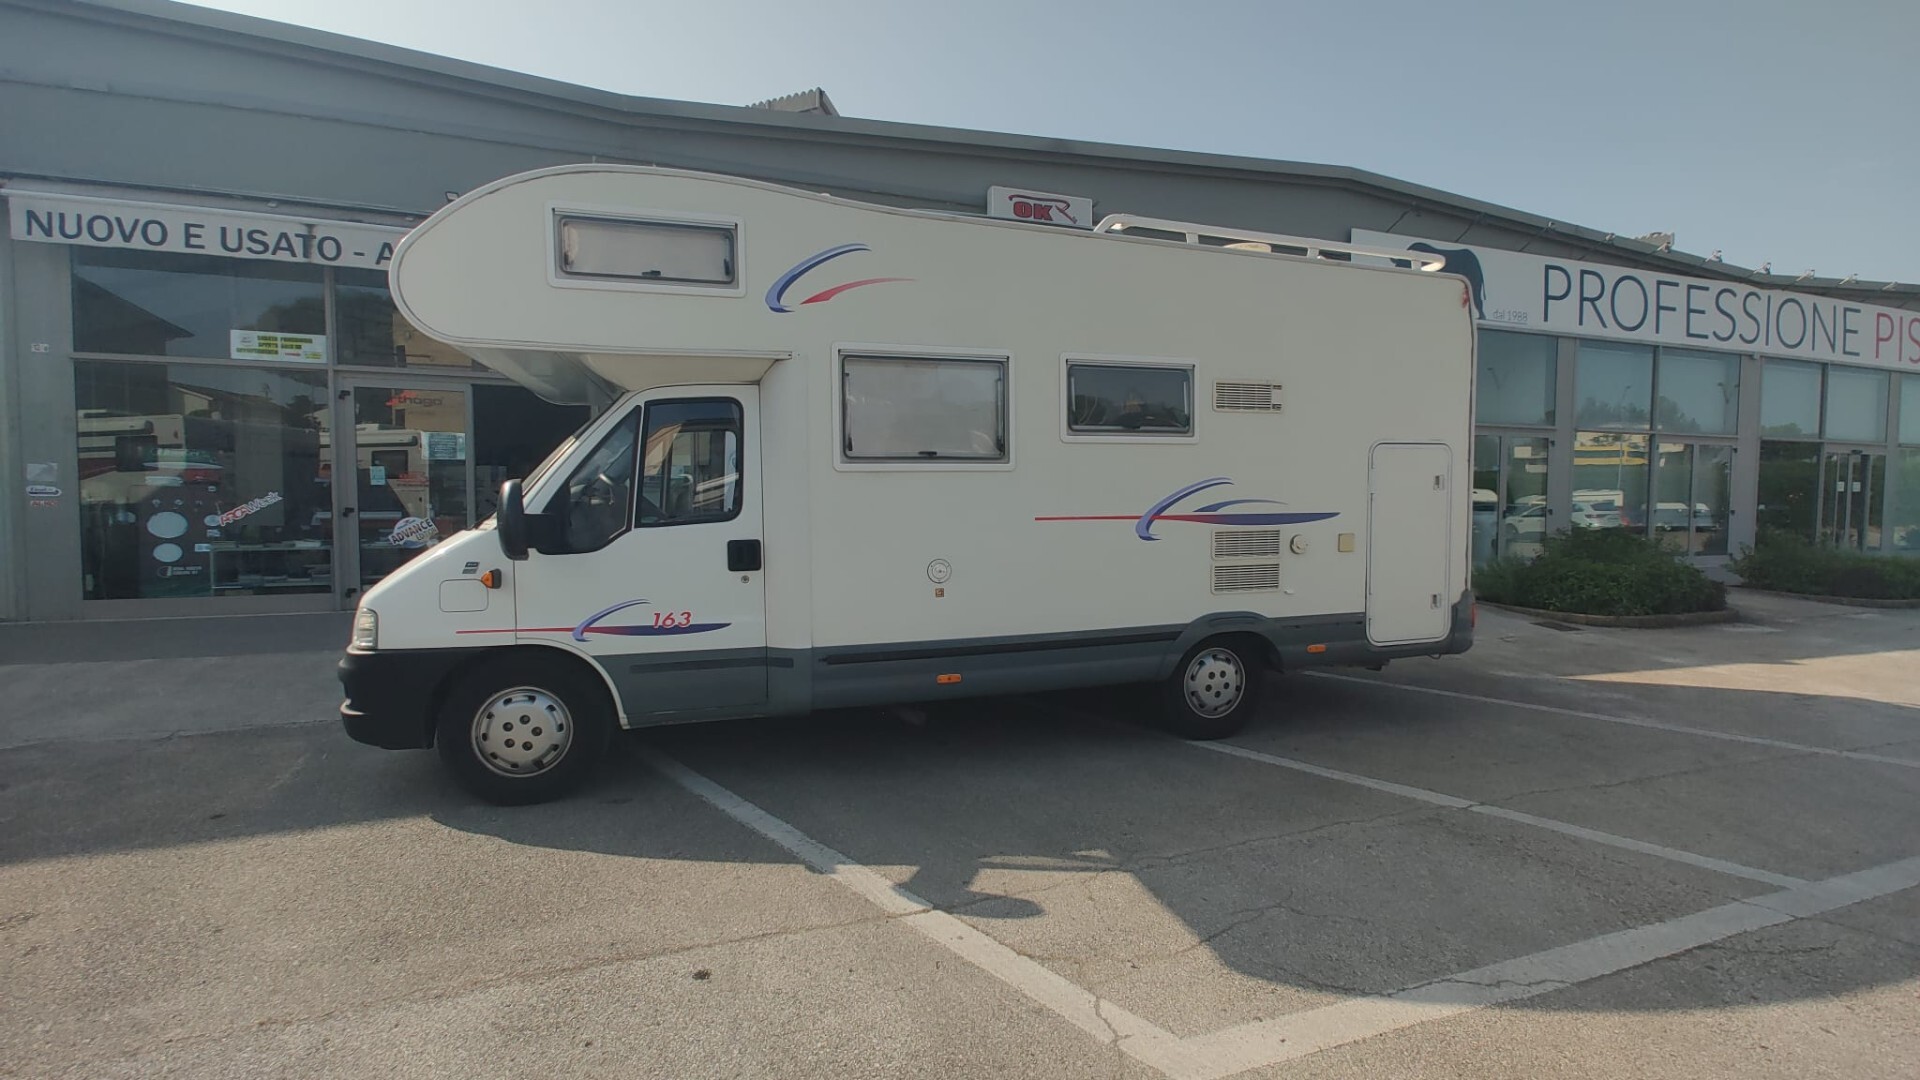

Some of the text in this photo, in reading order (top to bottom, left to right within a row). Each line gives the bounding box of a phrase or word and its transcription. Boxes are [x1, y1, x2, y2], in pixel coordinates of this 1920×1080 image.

[25, 209, 168, 248] NUOVO
[184, 223, 206, 250] E
[220, 226, 343, 261] USATO
[1493, 309, 1528, 322] dal 1988
[1543, 263, 1862, 358] PROFESSIONE
[390, 518, 433, 545] ADVANCE
[652, 611, 692, 629] 163
